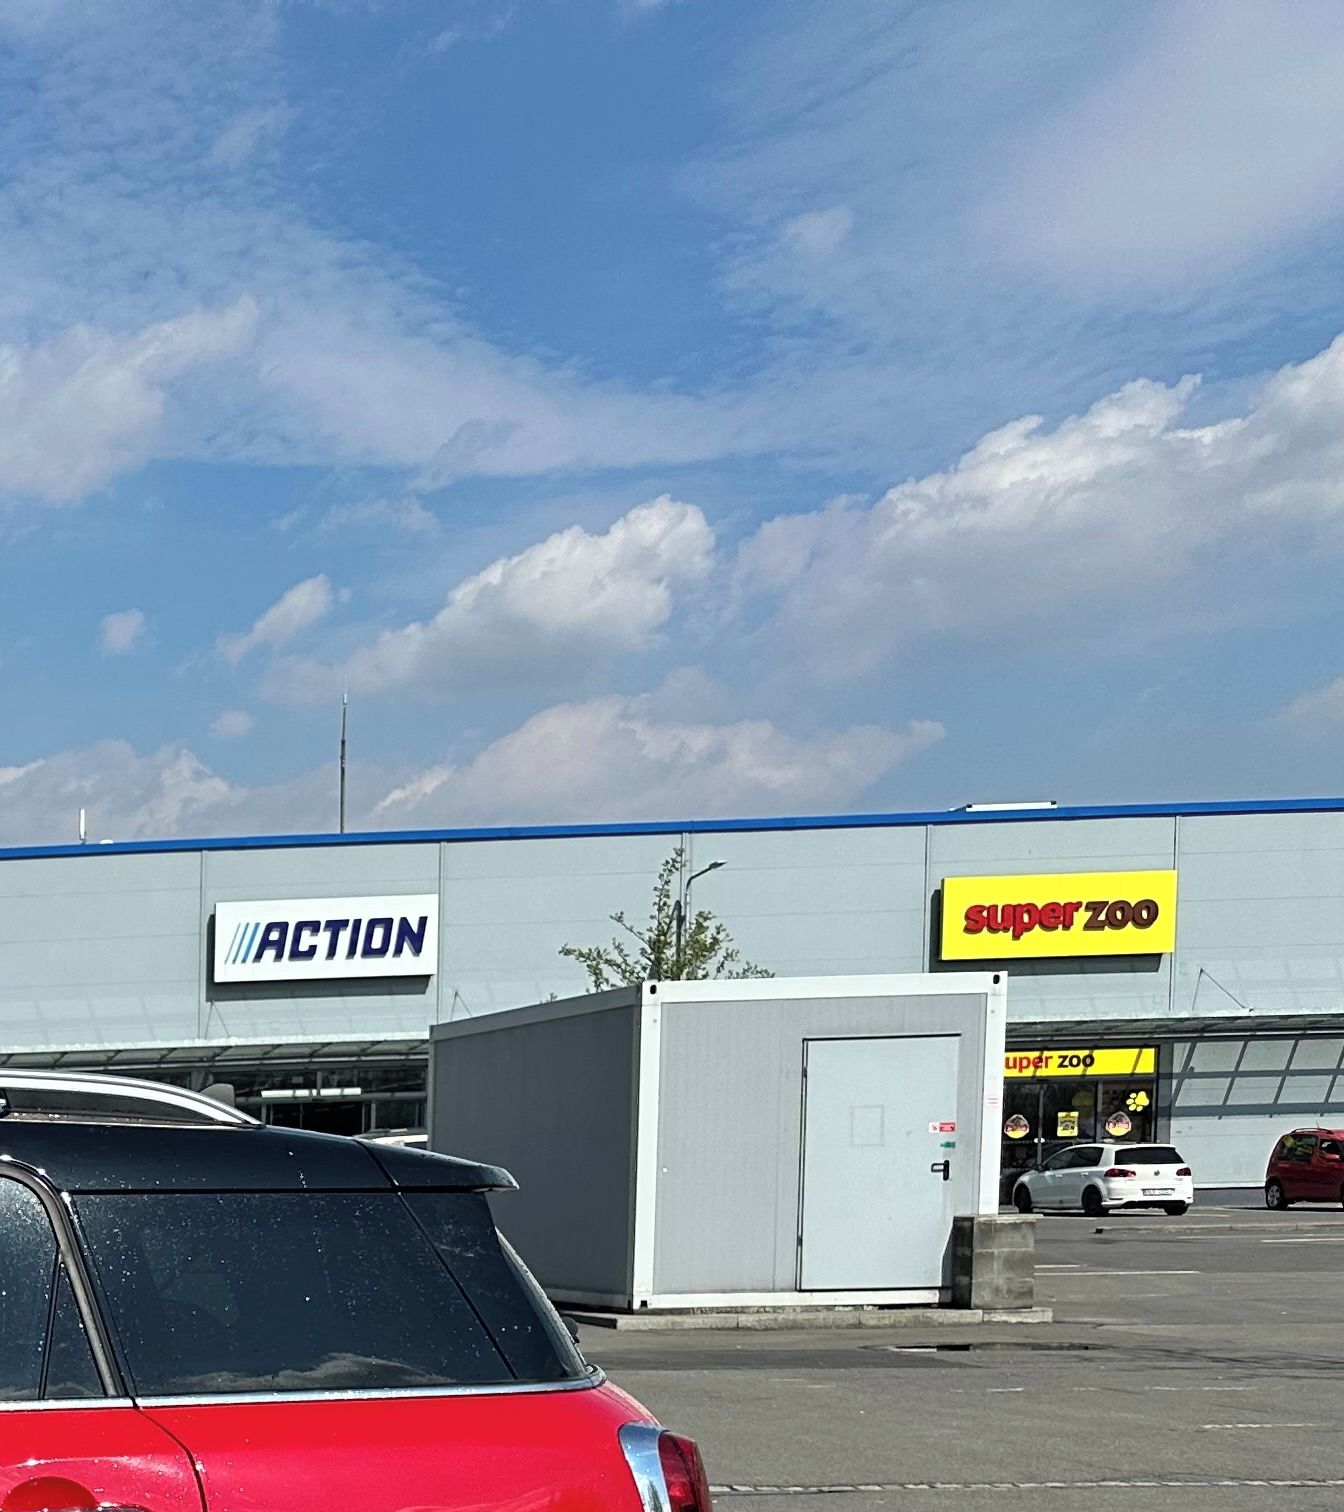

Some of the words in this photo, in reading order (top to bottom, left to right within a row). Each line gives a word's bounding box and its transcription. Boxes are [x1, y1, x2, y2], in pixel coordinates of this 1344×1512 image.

[252, 915, 429, 963] ACTION
[1004, 1054, 1053, 1073] uper
[1057, 1053, 1095, 1069] zoo
